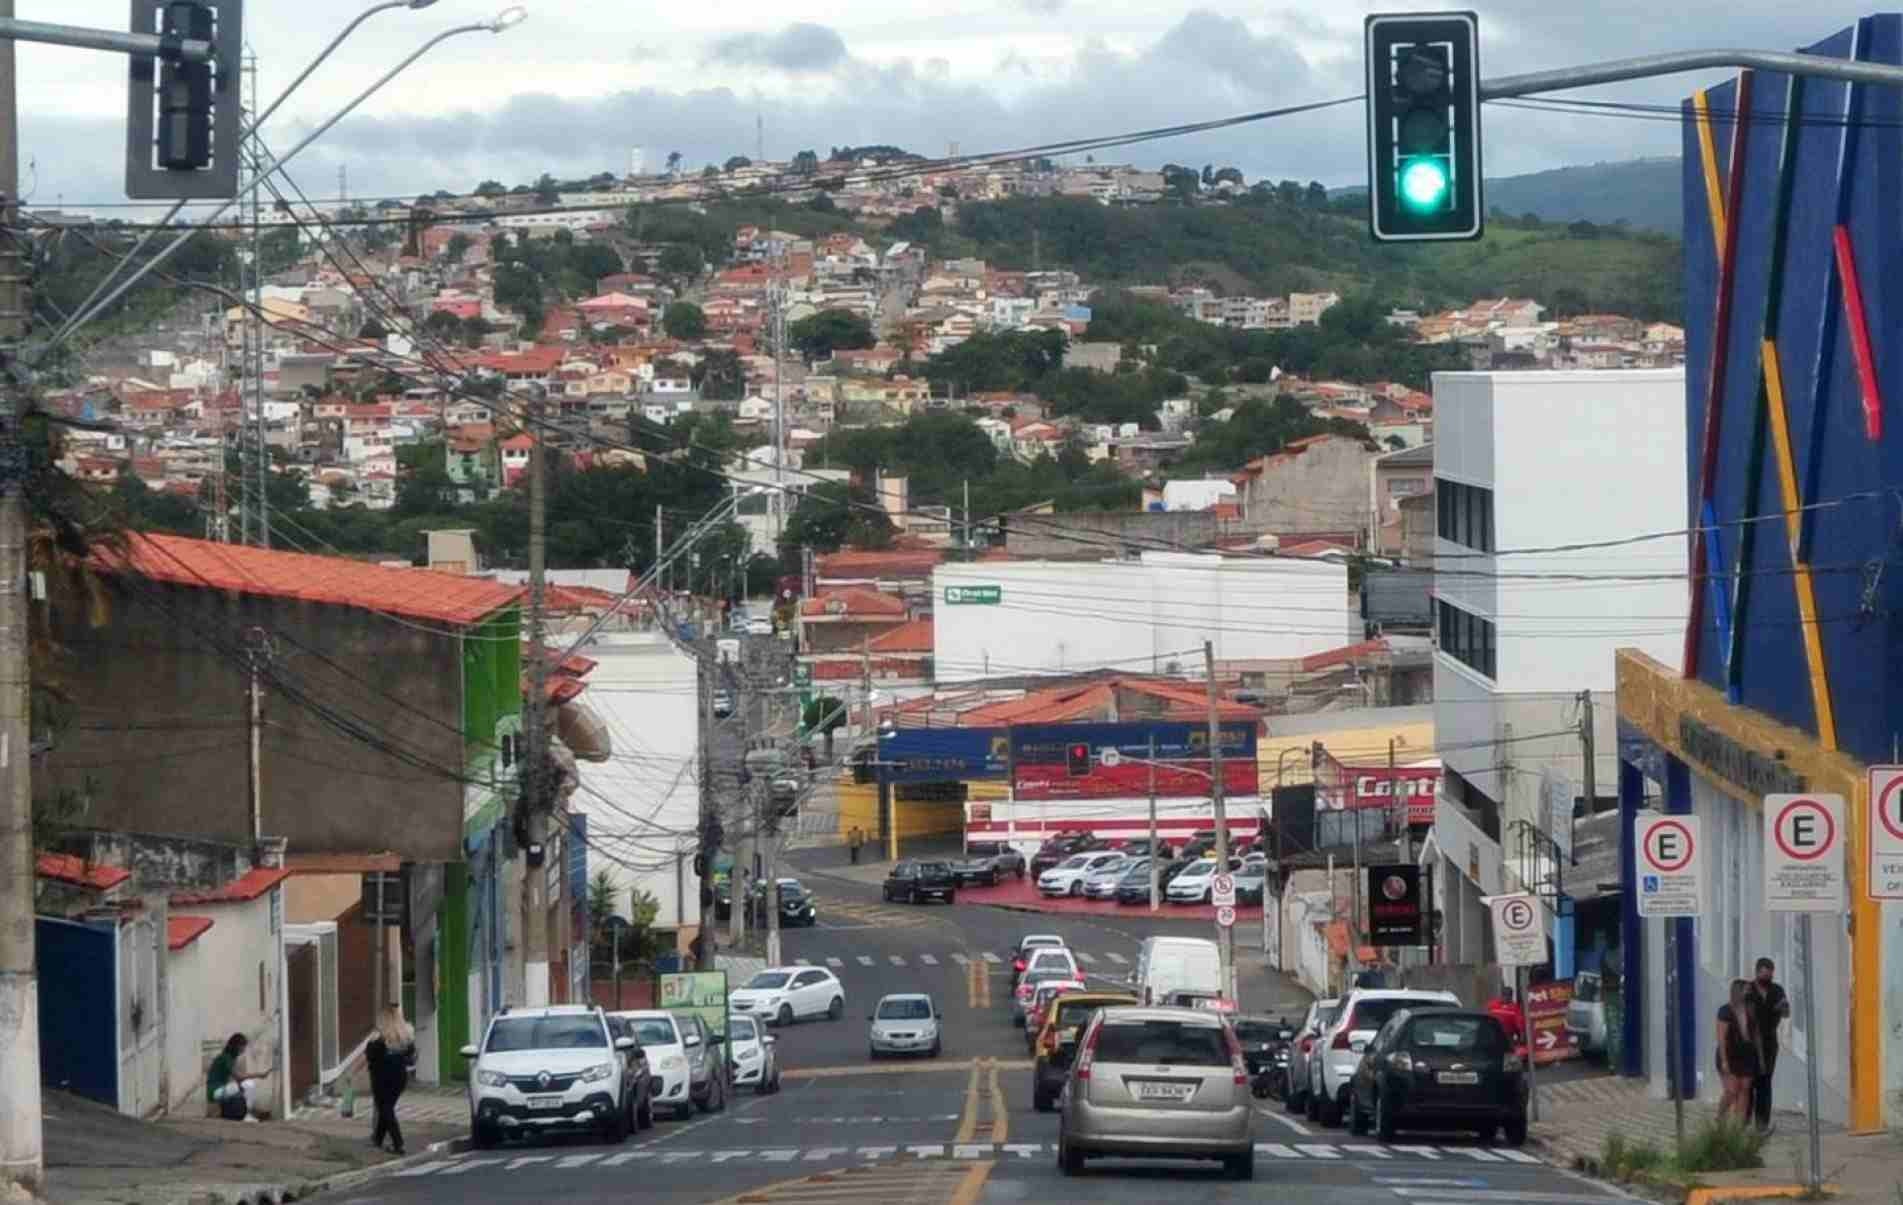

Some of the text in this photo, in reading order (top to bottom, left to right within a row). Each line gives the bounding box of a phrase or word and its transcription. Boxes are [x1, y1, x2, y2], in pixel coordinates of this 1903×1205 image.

[1793, 815, 1816, 847] E
[1659, 833, 1678, 860] E
[1511, 905, 1524, 925] E
